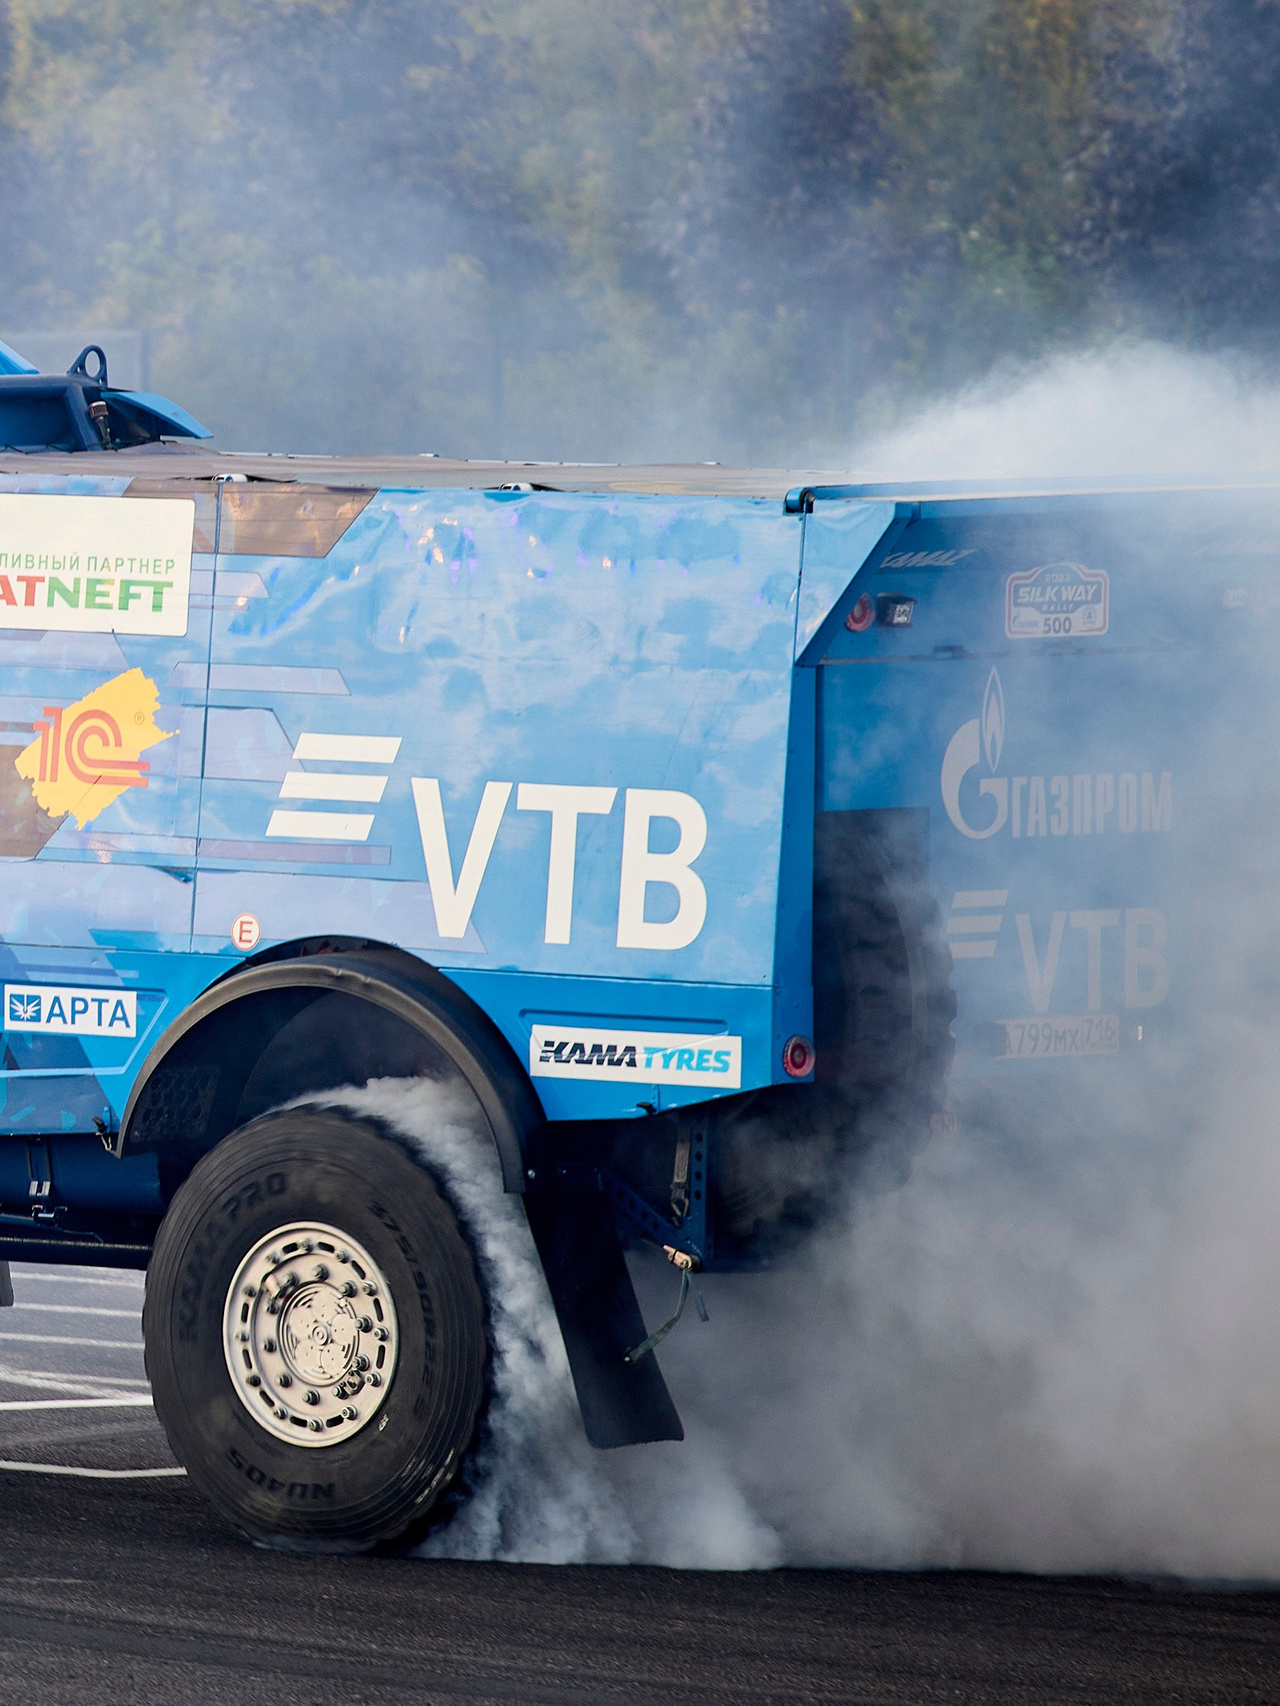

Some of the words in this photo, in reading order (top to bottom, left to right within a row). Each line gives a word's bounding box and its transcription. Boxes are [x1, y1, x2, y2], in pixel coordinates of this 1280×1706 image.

[87, 556, 175, 574] ПАРТНЕР
[1017, 587, 1058, 602] SILK
[1062, 584, 1098, 601] WAY
[1042, 603, 1074, 611] RALLY
[1043, 617, 1072, 634] 500
[1012, 771, 1173, 838] ГАЗПРОМ
[411, 777, 707, 950] VTB
[239, 919, 253, 944] E
[1014, 907, 1172, 1014] VTB
[539, 1040, 637, 1067] KAMA
[643, 1046, 731, 1073] TYRES
